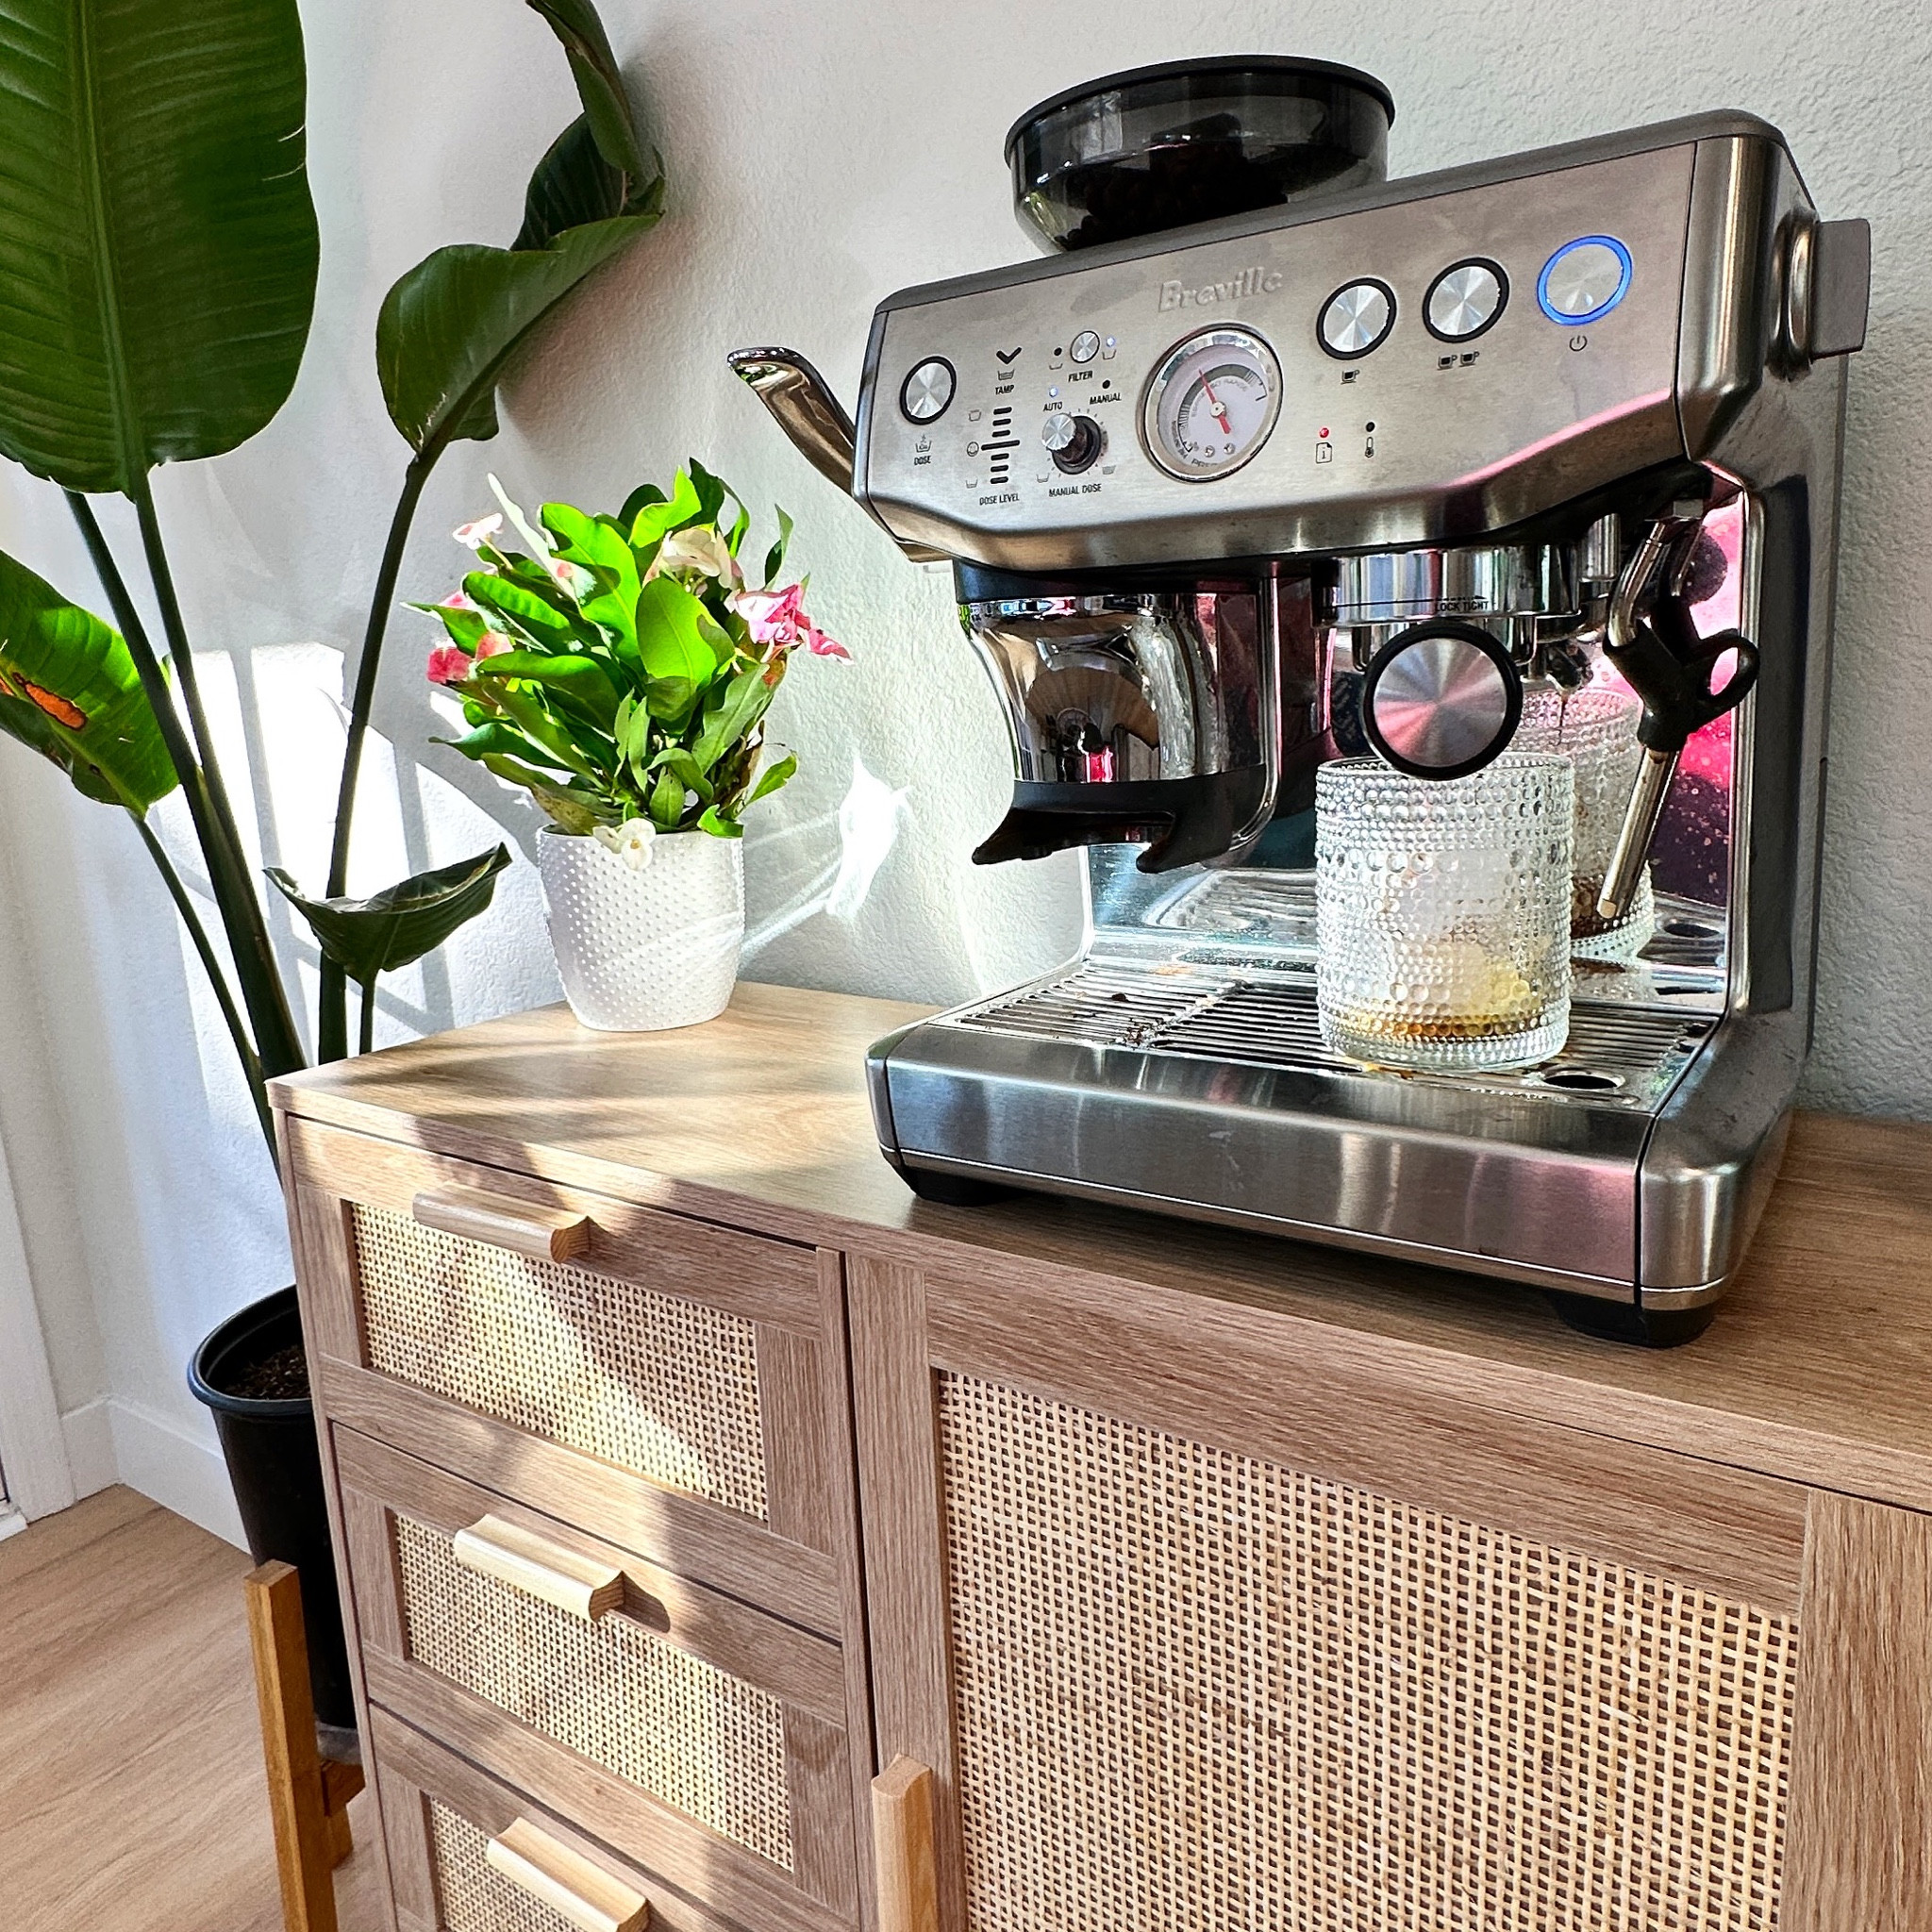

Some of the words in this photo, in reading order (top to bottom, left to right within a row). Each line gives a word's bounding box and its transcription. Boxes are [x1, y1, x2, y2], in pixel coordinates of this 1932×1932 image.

[1068, 371, 1093, 383] FILTER
[995, 385, 1015, 395] TAMP
[1090, 392, 1122, 406] MANUAL
[1043, 402, 1063, 412] AUTO
[913, 456, 932, 466] DOSE
[1048, 486, 1079, 498] MANUAL
[1082, 483, 1103, 494] DOSE
[979, 495, 998, 506] DOSE
[999, 493, 1020, 504] LEVEL
